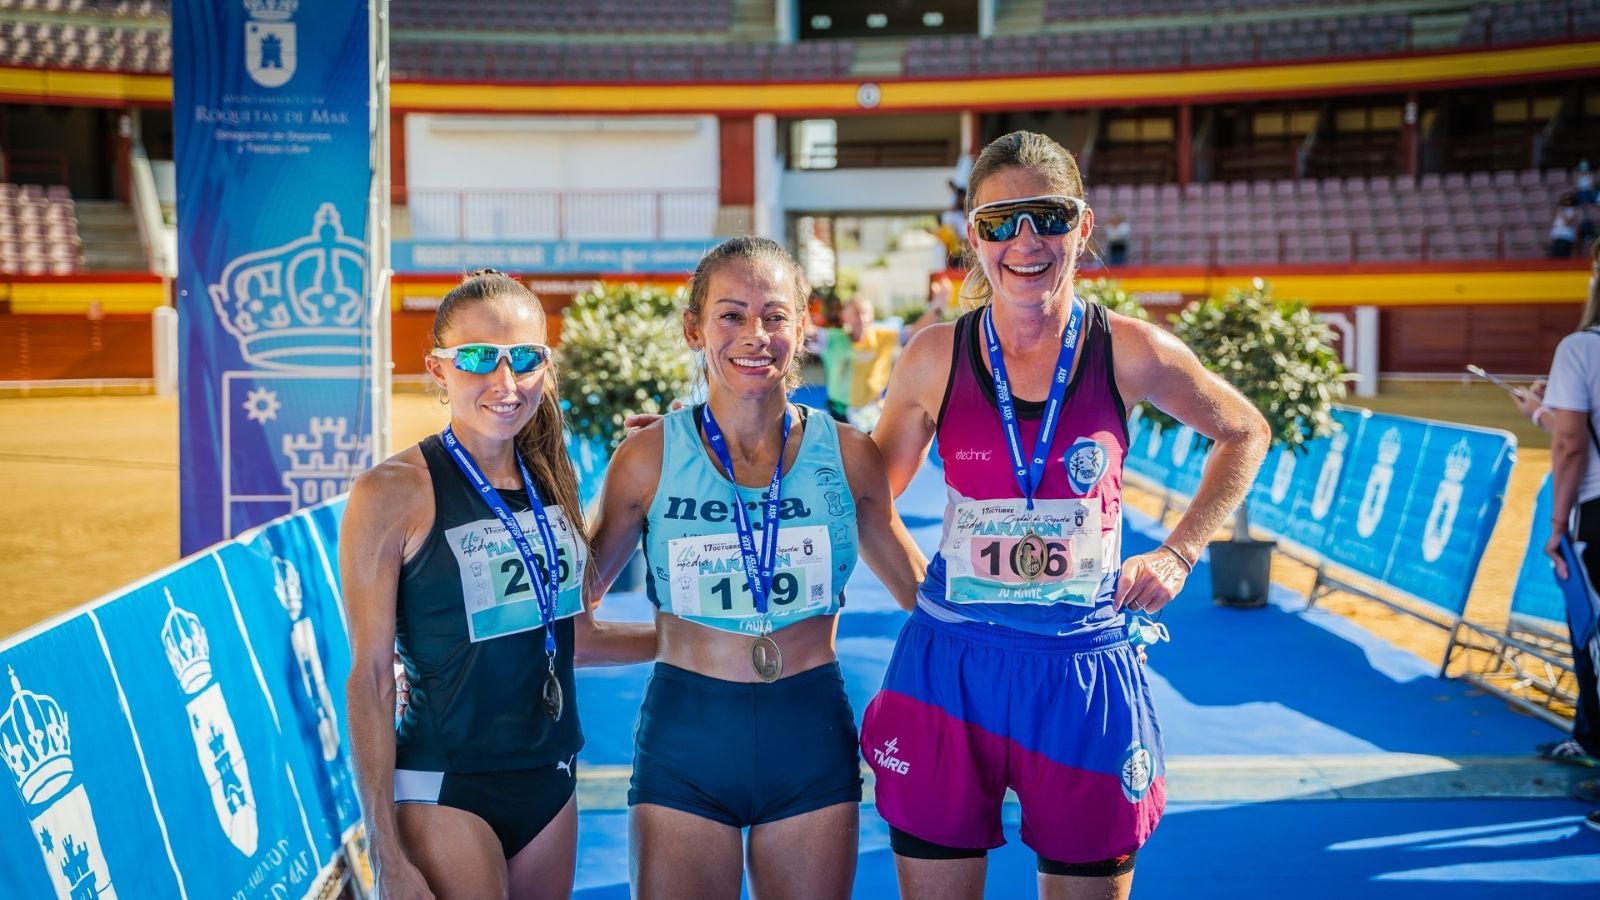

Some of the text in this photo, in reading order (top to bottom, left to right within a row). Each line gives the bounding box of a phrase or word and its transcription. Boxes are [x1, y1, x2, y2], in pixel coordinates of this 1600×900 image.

[310, 109, 349, 124] MAR
[664, 492, 811, 530] nerja
[971, 519, 1061, 536] MARATON
[699, 552, 791, 575] MARN
[873, 748, 910, 775] TMRG
